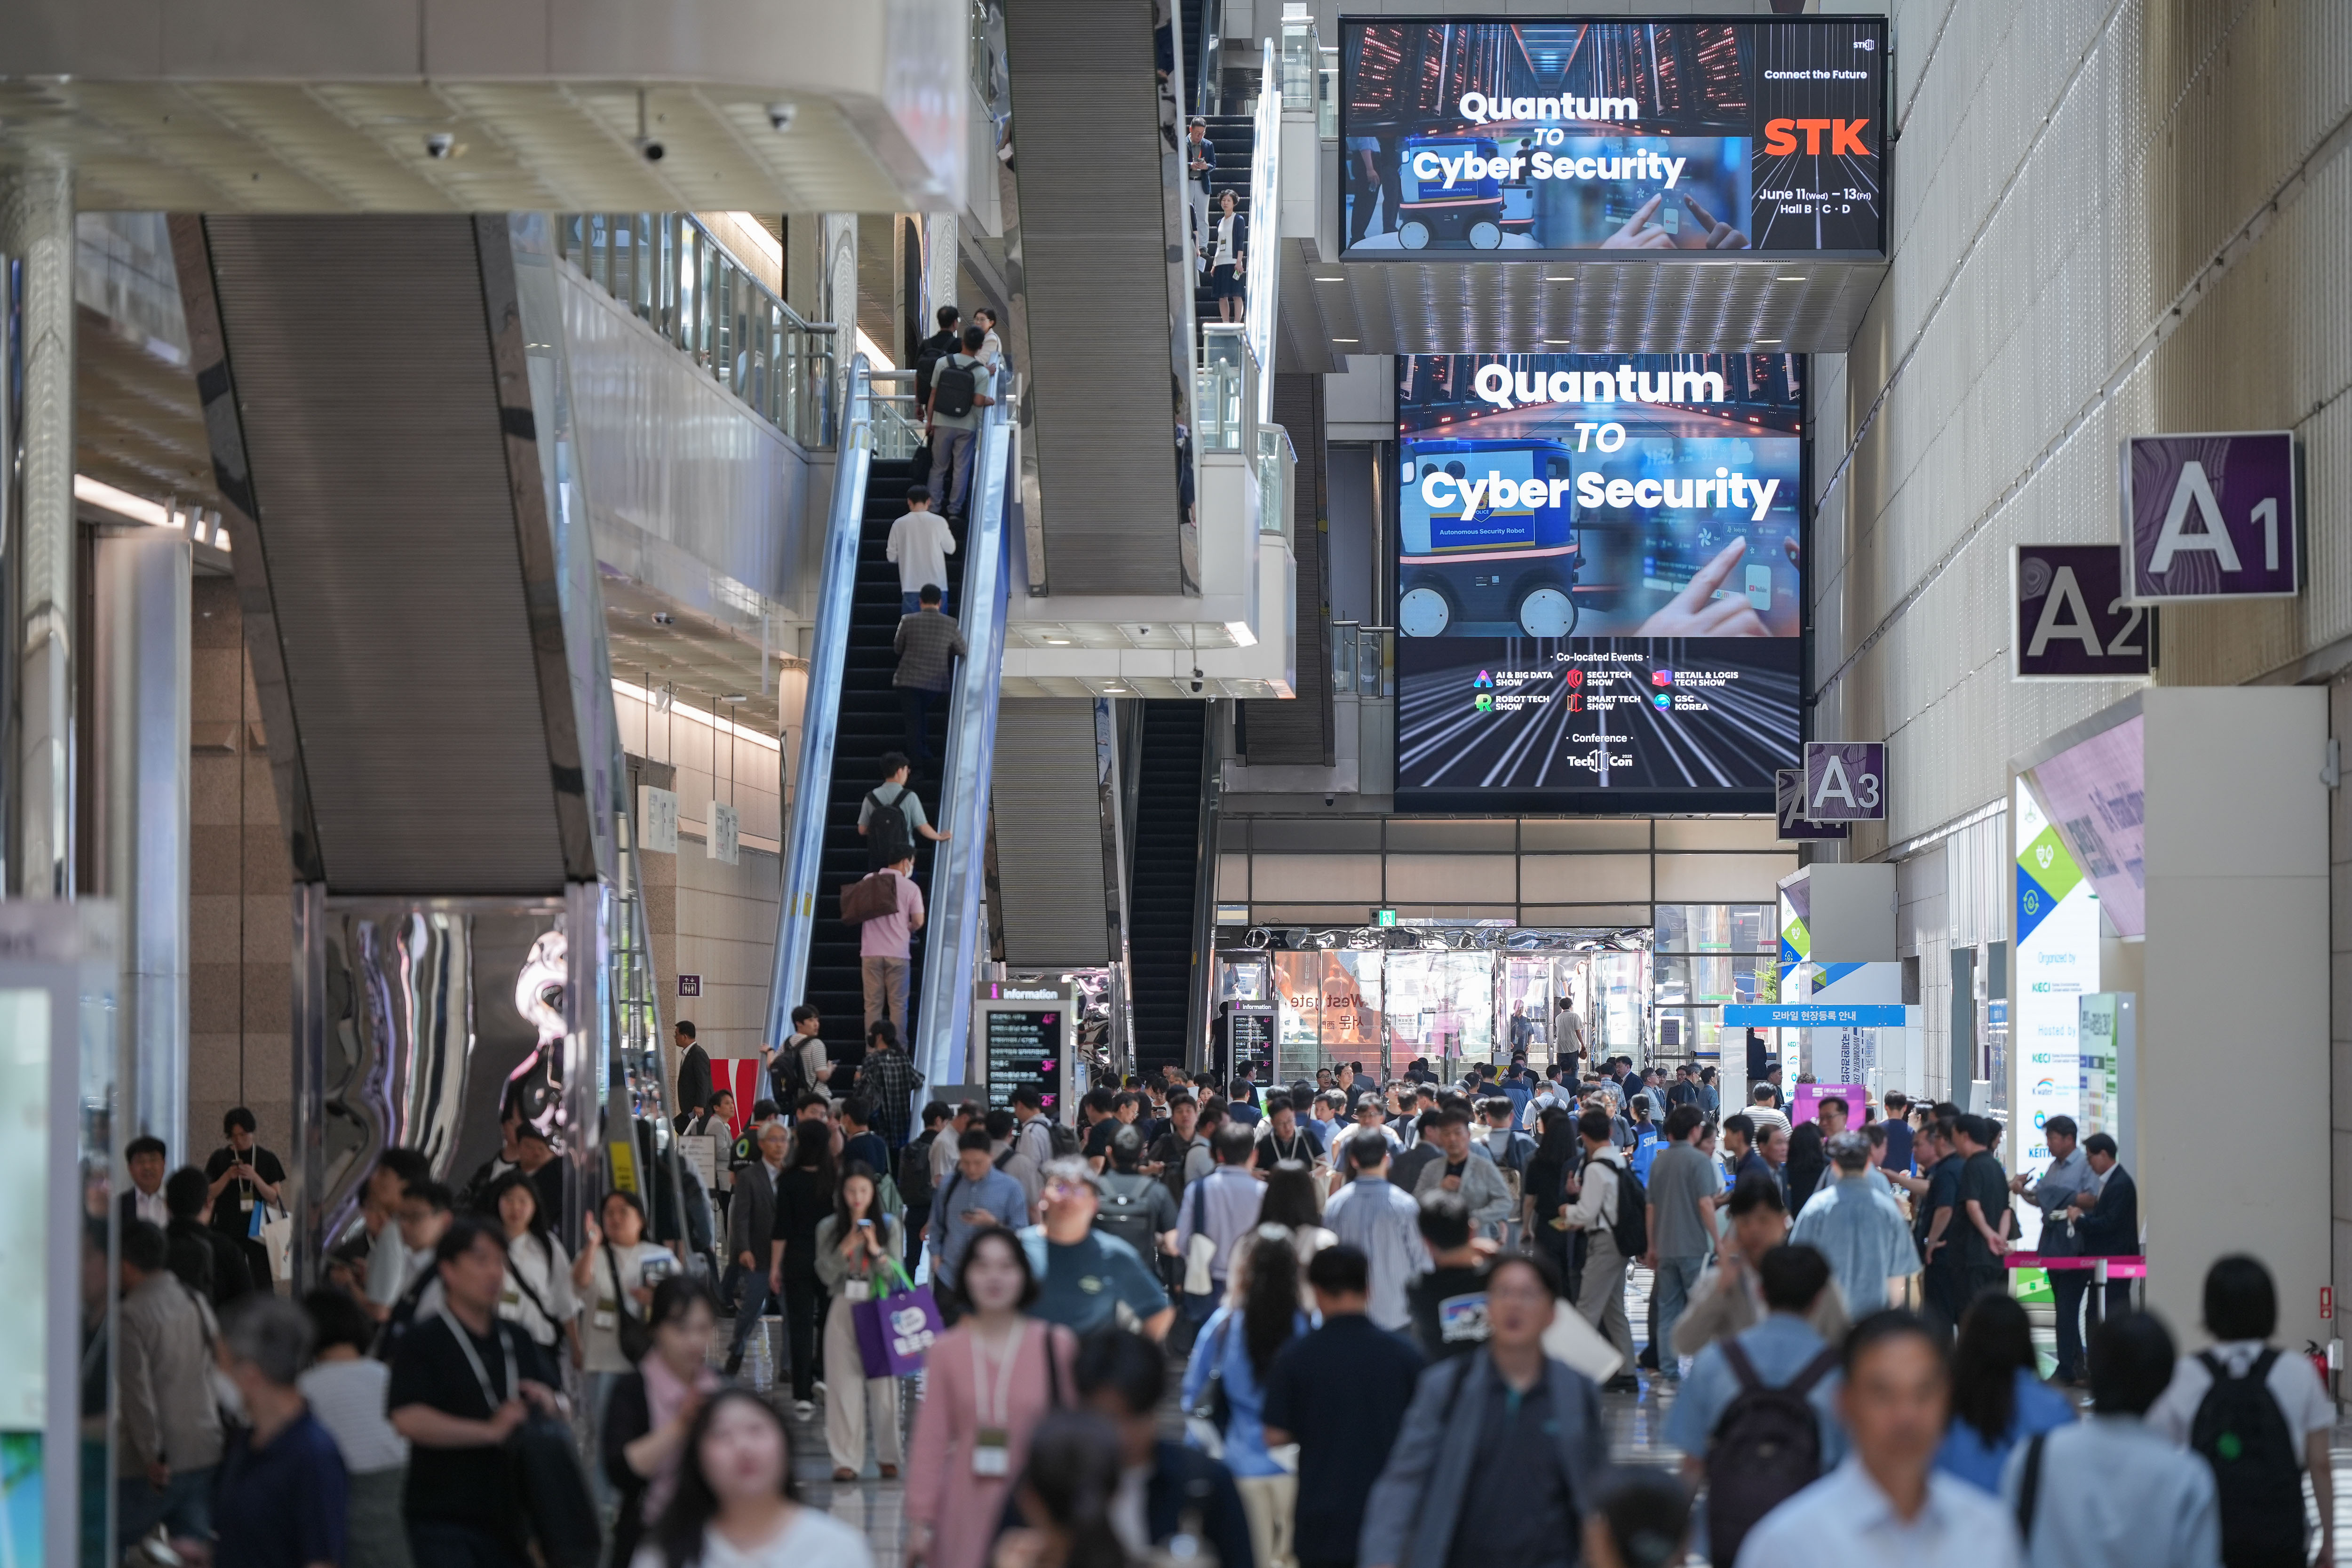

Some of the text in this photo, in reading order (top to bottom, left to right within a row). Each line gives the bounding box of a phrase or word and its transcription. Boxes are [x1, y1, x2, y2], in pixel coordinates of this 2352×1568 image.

[1764, 70, 1867, 79] Connect the Future
[1459, 92, 1637, 126] Quantum
[1534, 128, 1564, 145] TO
[1764, 118, 1870, 156] STK
[1413, 148, 1686, 189] Cyber Security
[1759, 189, 1793, 200] June
[1780, 205, 1802, 214] Hall
[1822, 205, 1831, 214] C
[1474, 364, 1724, 410] Quantum
[1573, 422, 1626, 453] TO
[1422, 467, 1780, 521] Cyber Security
[2147, 461, 2279, 573] A1
[2026, 565, 2143, 657] A2
[1557, 653, 1643, 661] Co-located Events
[1572, 733, 1627, 742] Conference
[1567, 756, 1633, 766] Tech Con
[1812, 755, 1879, 808] A3
[2038, 952, 2075, 965] Organized by
[2032, 982, 2050, 992] KECI
[1003, 988, 1058, 1000] information
[1042, 1013, 1056, 1024] 4F
[1772, 1011, 1856, 1021] 모바일 현장등록 안내
[2038, 1024, 2075, 1037] Hosted by
[2032, 1053, 2050, 1063] KECI
[1042, 1060, 1056, 1071] 3F
[1041, 1095, 1055, 1106] 2F
